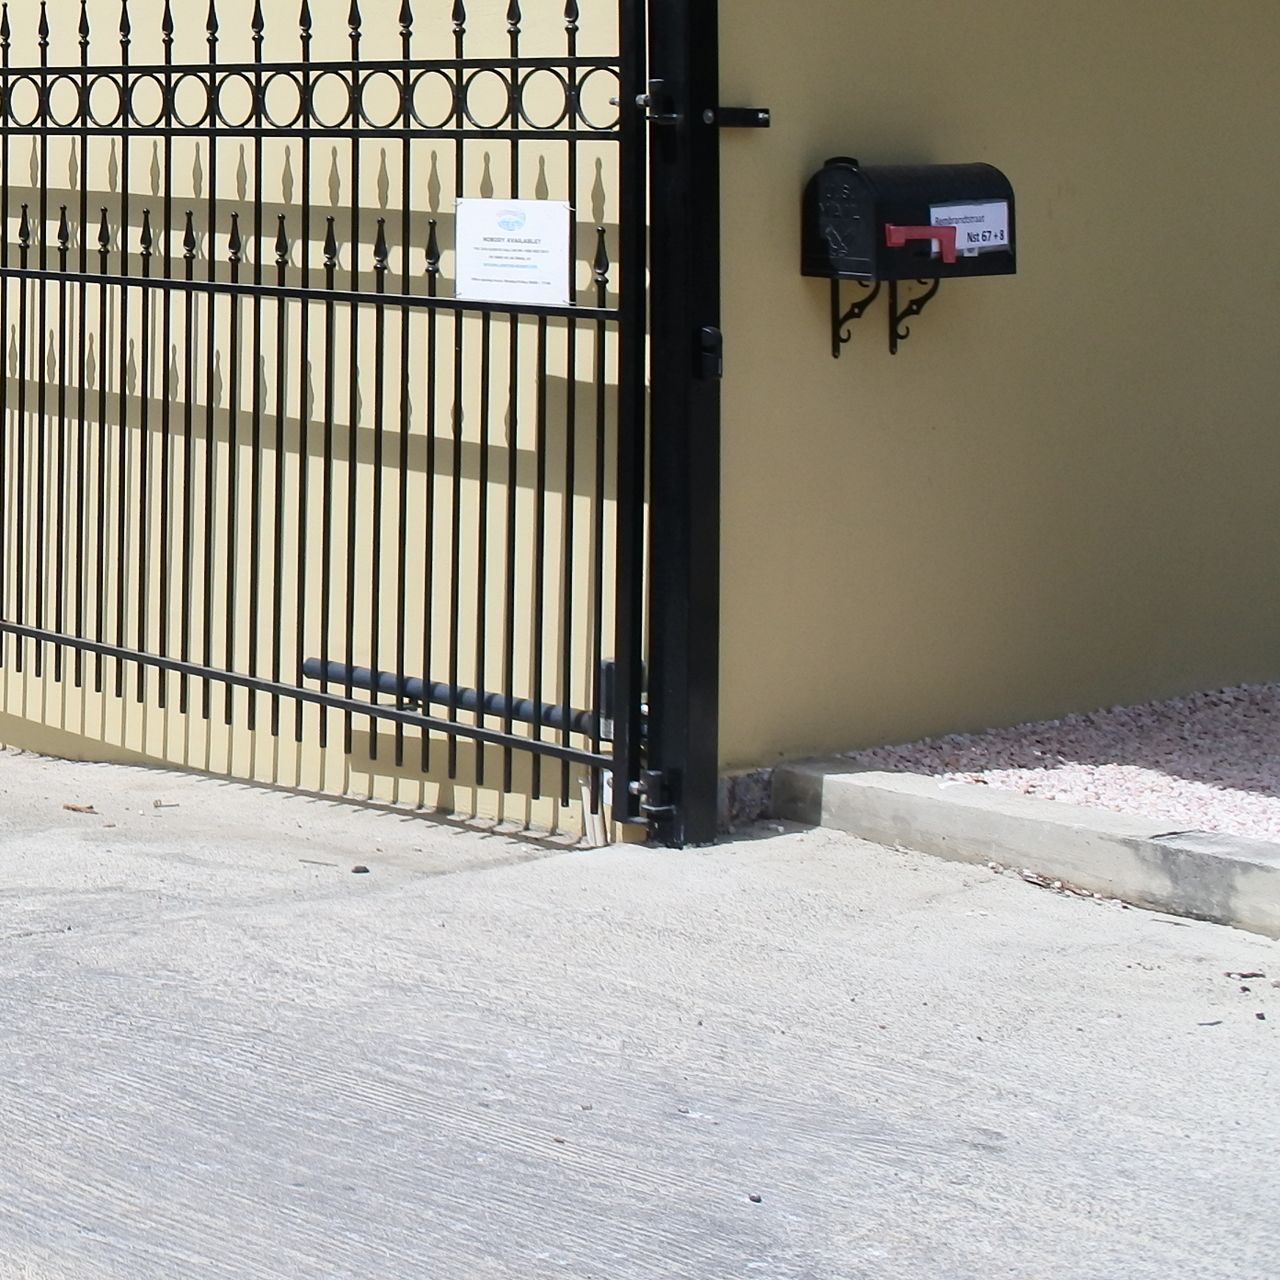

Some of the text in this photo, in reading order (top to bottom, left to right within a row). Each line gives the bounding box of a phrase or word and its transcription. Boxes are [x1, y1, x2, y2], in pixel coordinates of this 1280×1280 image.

[967, 231, 980, 243] Nst
[981, 230, 992, 242] 67
[999, 229, 1005, 241] 8
